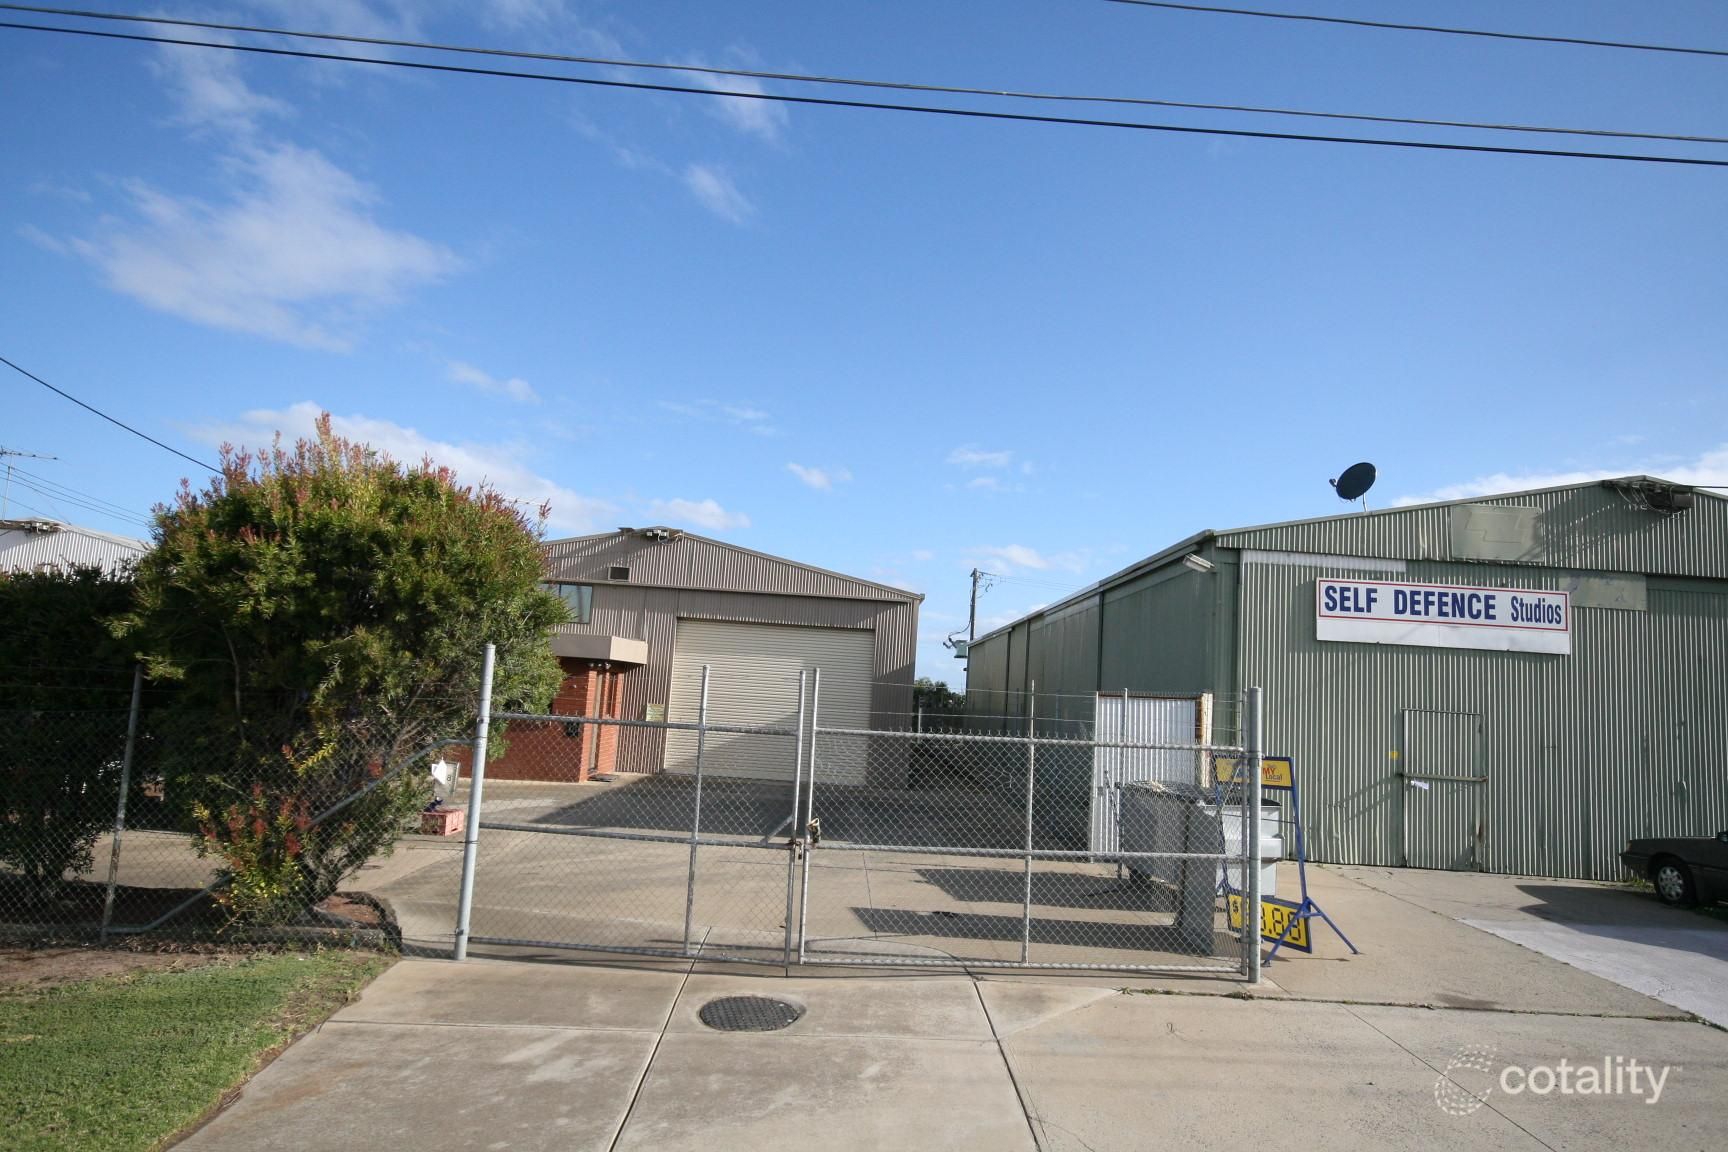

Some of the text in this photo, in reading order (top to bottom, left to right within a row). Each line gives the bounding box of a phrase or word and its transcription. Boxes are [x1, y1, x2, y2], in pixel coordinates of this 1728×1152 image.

[1325, 586, 1562, 624] SELF DEFENCE Studios
